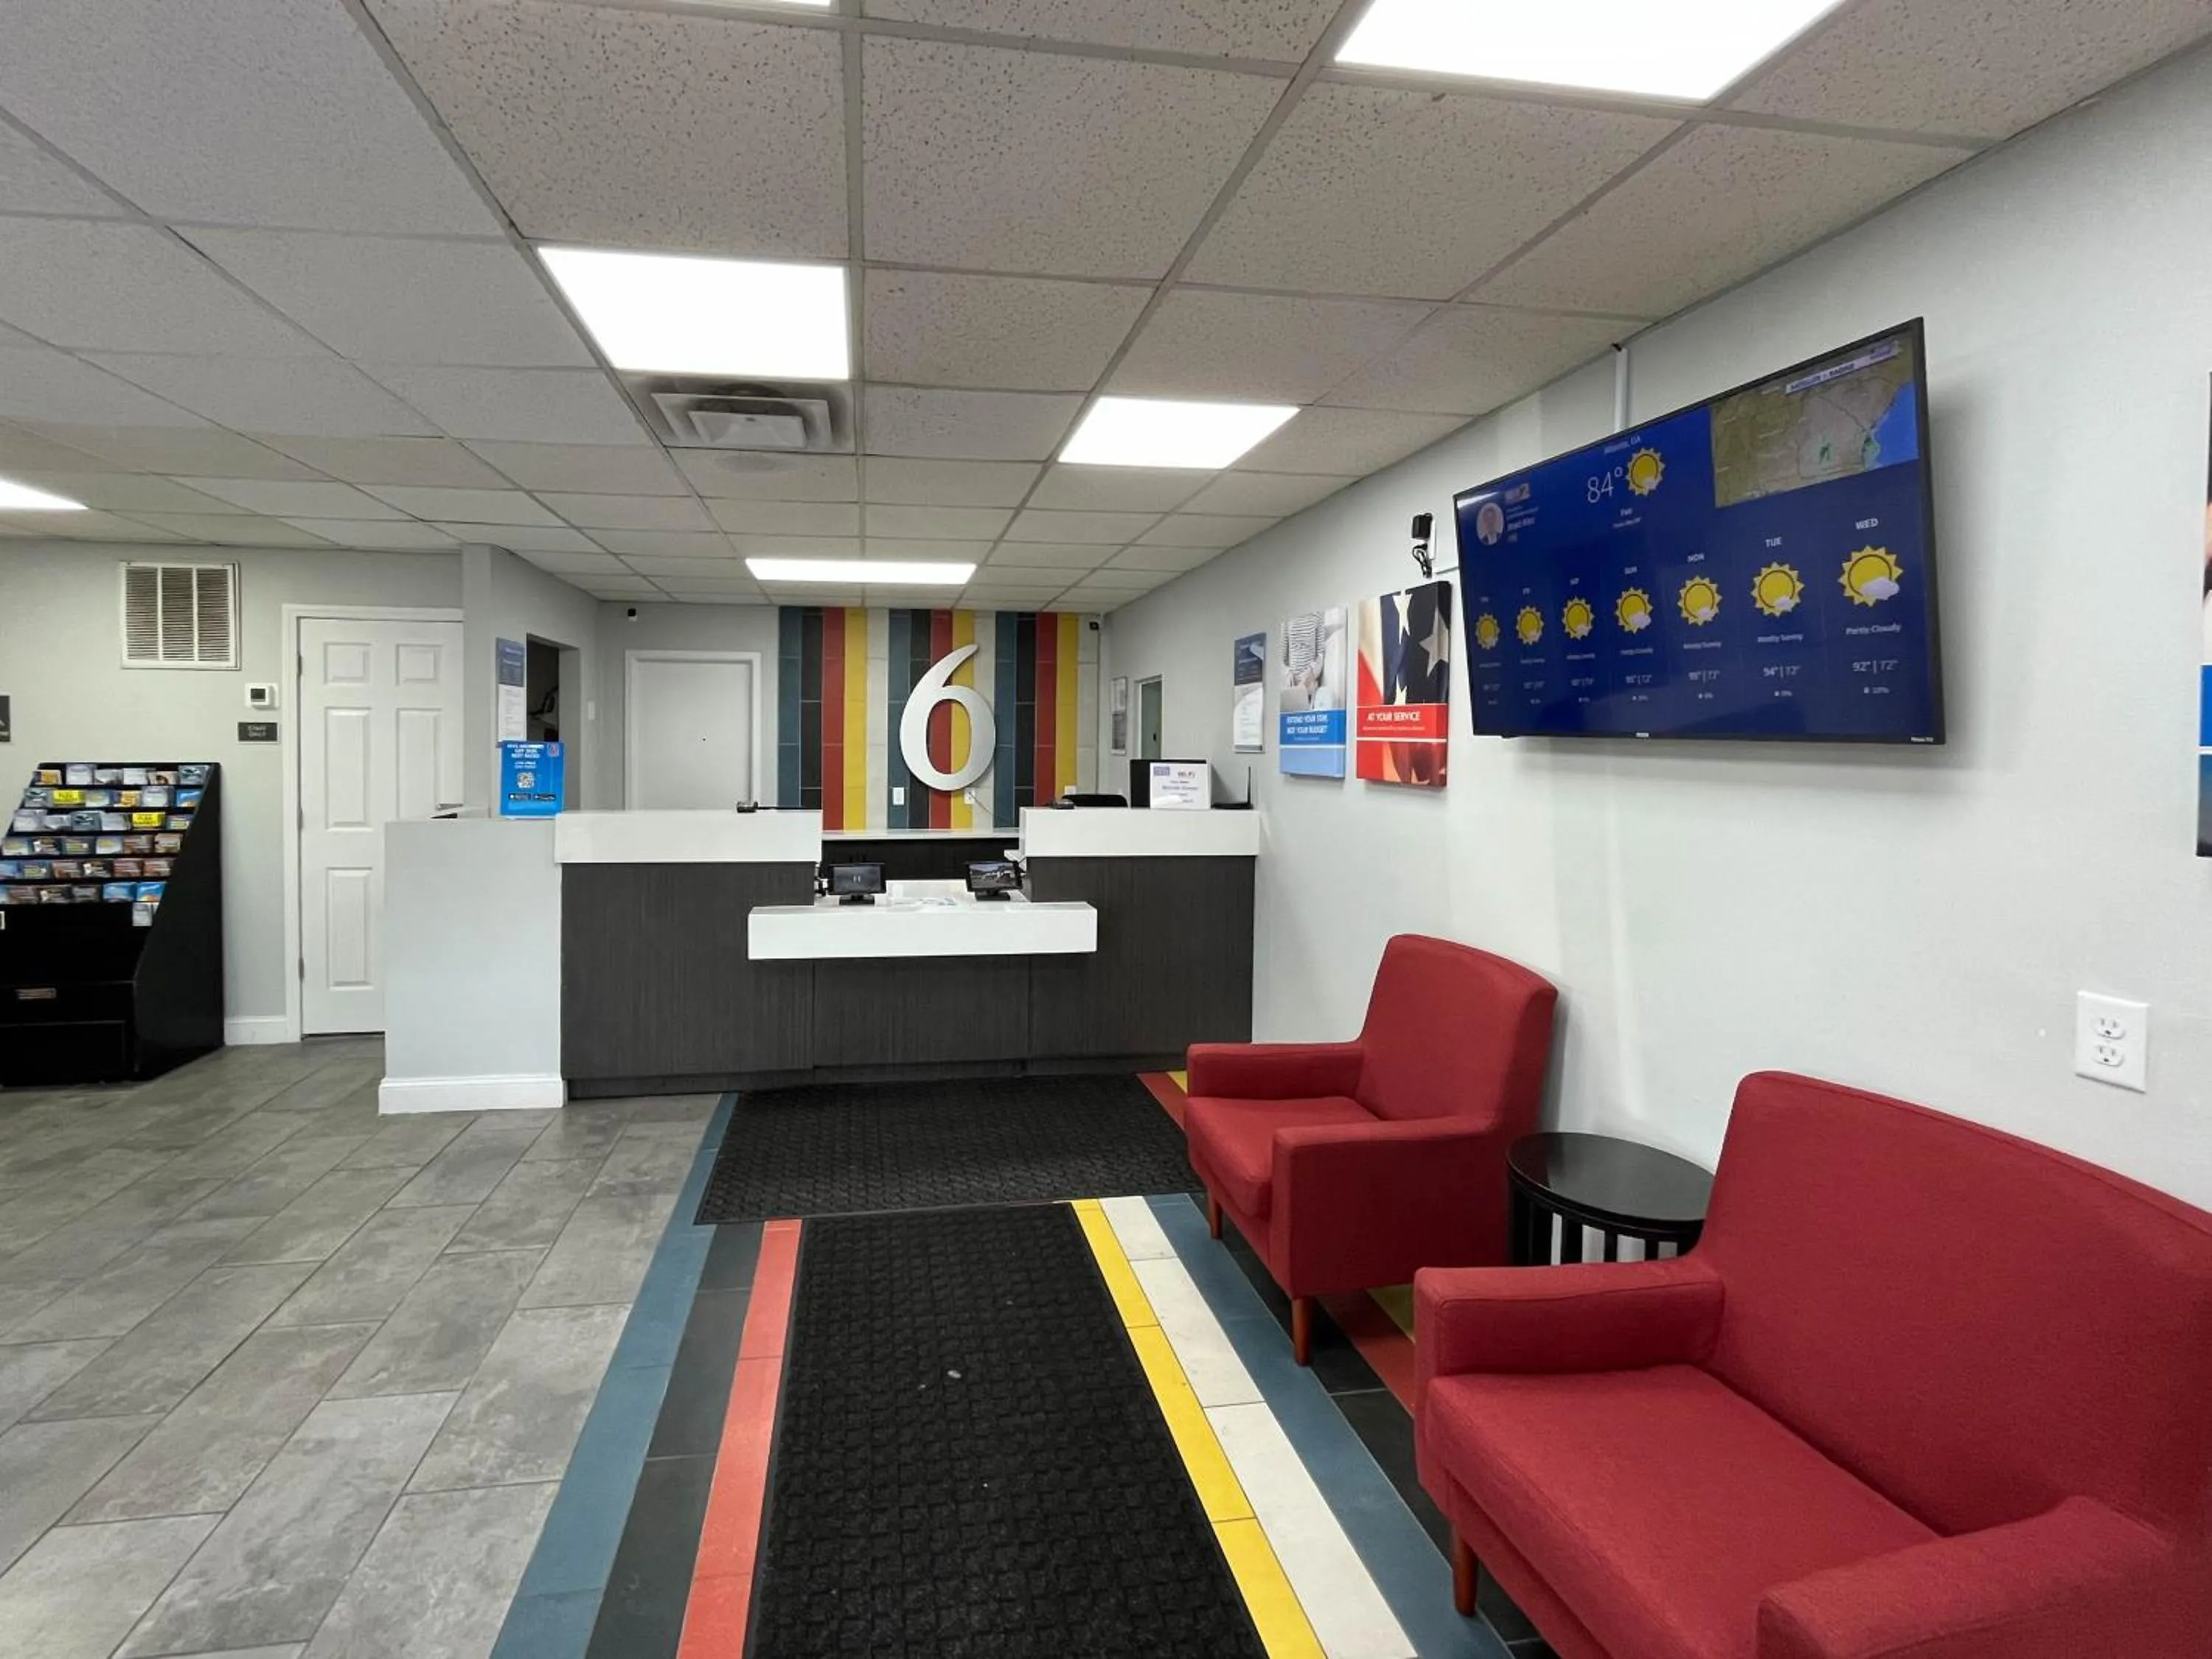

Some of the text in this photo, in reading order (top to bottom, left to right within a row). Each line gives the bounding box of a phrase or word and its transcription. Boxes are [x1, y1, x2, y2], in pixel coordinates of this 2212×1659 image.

[1587, 466, 1623, 503] 84°
[1855, 518, 1878, 529] WED
[1765, 536, 1781, 548] TUE
[900, 644, 995, 790] 6
[1366, 710, 1421, 722] AT YOUR SERVICE
